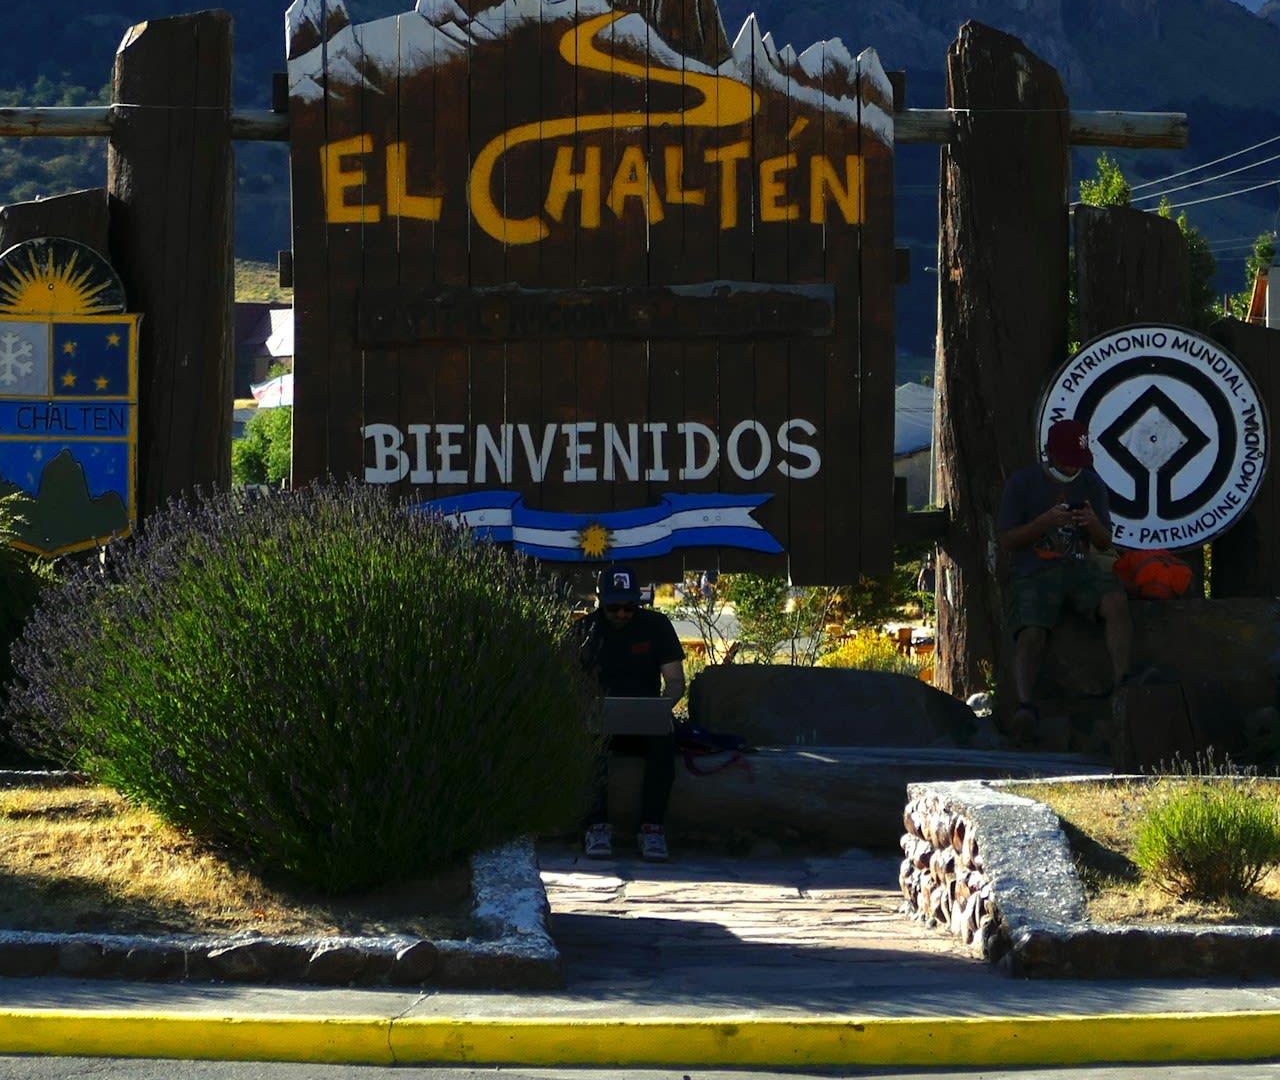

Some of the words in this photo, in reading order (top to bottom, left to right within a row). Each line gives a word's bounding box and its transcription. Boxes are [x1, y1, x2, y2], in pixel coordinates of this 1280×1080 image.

[320, 134, 442, 224] EL
[469, 116, 864, 245] CHALTÉN
[1062, 332, 1168, 393] PATRIMONIO
[1171, 335, 1244, 396] MUNDIAL
[16, 405, 126, 431] CHALTEN
[361, 418, 822, 484] BIENVENIDOS
[1139, 492, 1241, 544] PATRIMOINE
[1236, 403, 1265, 495] MONDIAL
